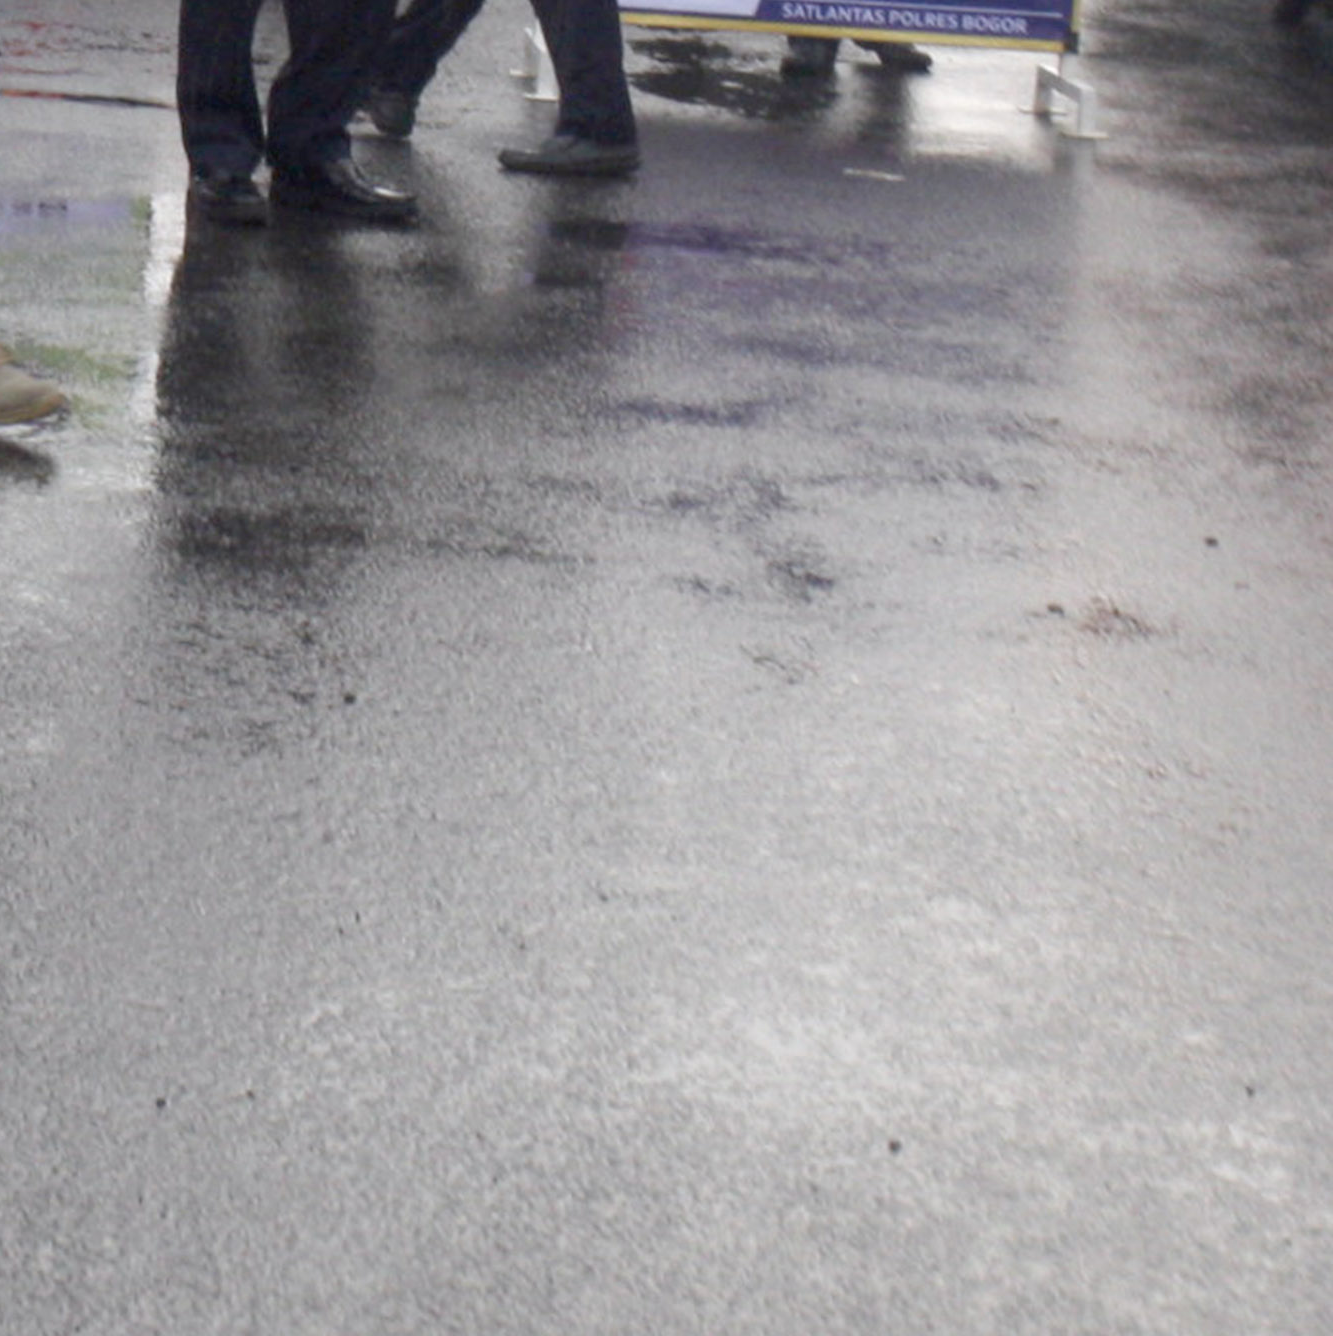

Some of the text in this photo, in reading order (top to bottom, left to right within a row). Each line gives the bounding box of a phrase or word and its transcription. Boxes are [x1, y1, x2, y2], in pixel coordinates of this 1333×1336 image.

[783, 1, 1028, 35] SATLANTAS POLRES BOGOR
